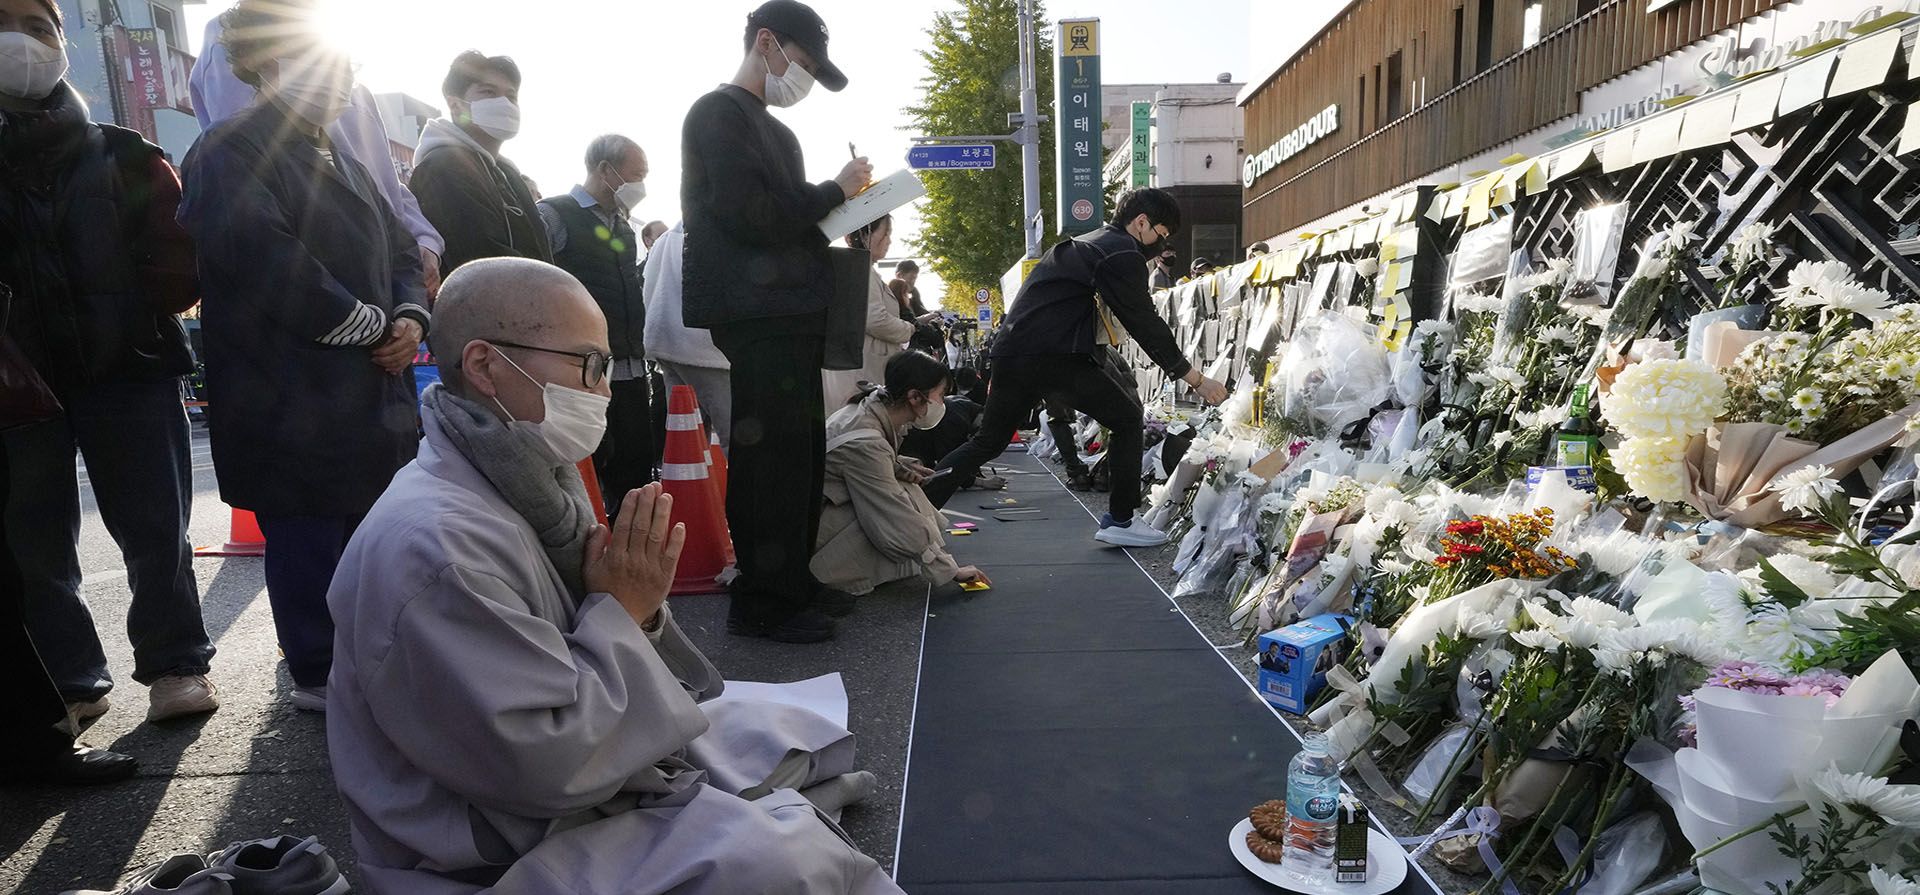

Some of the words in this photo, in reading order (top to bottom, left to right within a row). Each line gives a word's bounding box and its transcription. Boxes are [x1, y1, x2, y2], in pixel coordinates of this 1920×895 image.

[138, 46, 158, 104] 노래연습장
[1076, 59, 1082, 76] 1
[1073, 92, 1089, 157] 이태원
[1135, 134, 1148, 164] 치과
[1254, 103, 1338, 178] TROUBADOUR
[961, 148, 991, 158] 보광로
[1074, 206, 1091, 215] 630
[979, 291, 987, 299] 50
